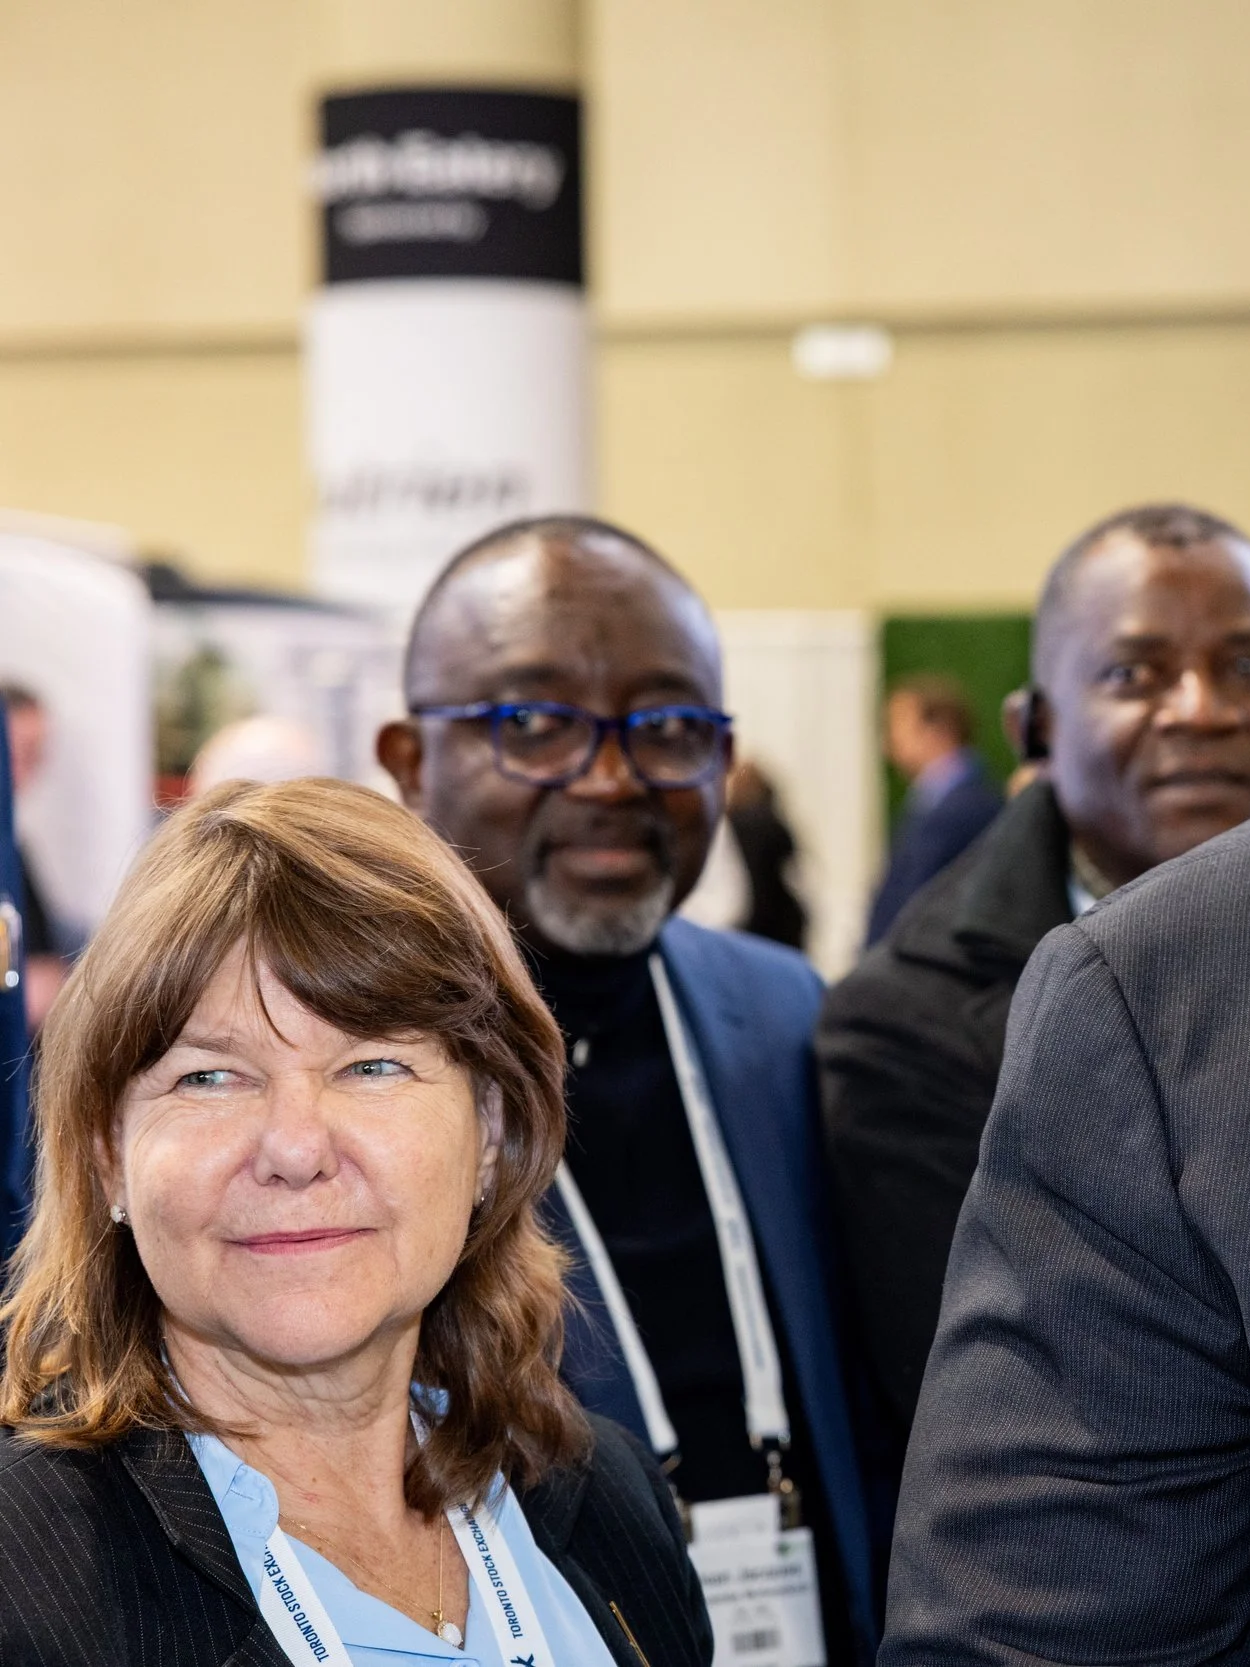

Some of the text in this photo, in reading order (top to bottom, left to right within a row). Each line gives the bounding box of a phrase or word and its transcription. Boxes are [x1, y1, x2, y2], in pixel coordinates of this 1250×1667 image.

[481, 1555, 503, 1588] STOCK
[272, 1576, 300, 1612] STOCK
[496, 1590, 523, 1639] TORONTO
[293, 1612, 329, 1662] TORONTO
